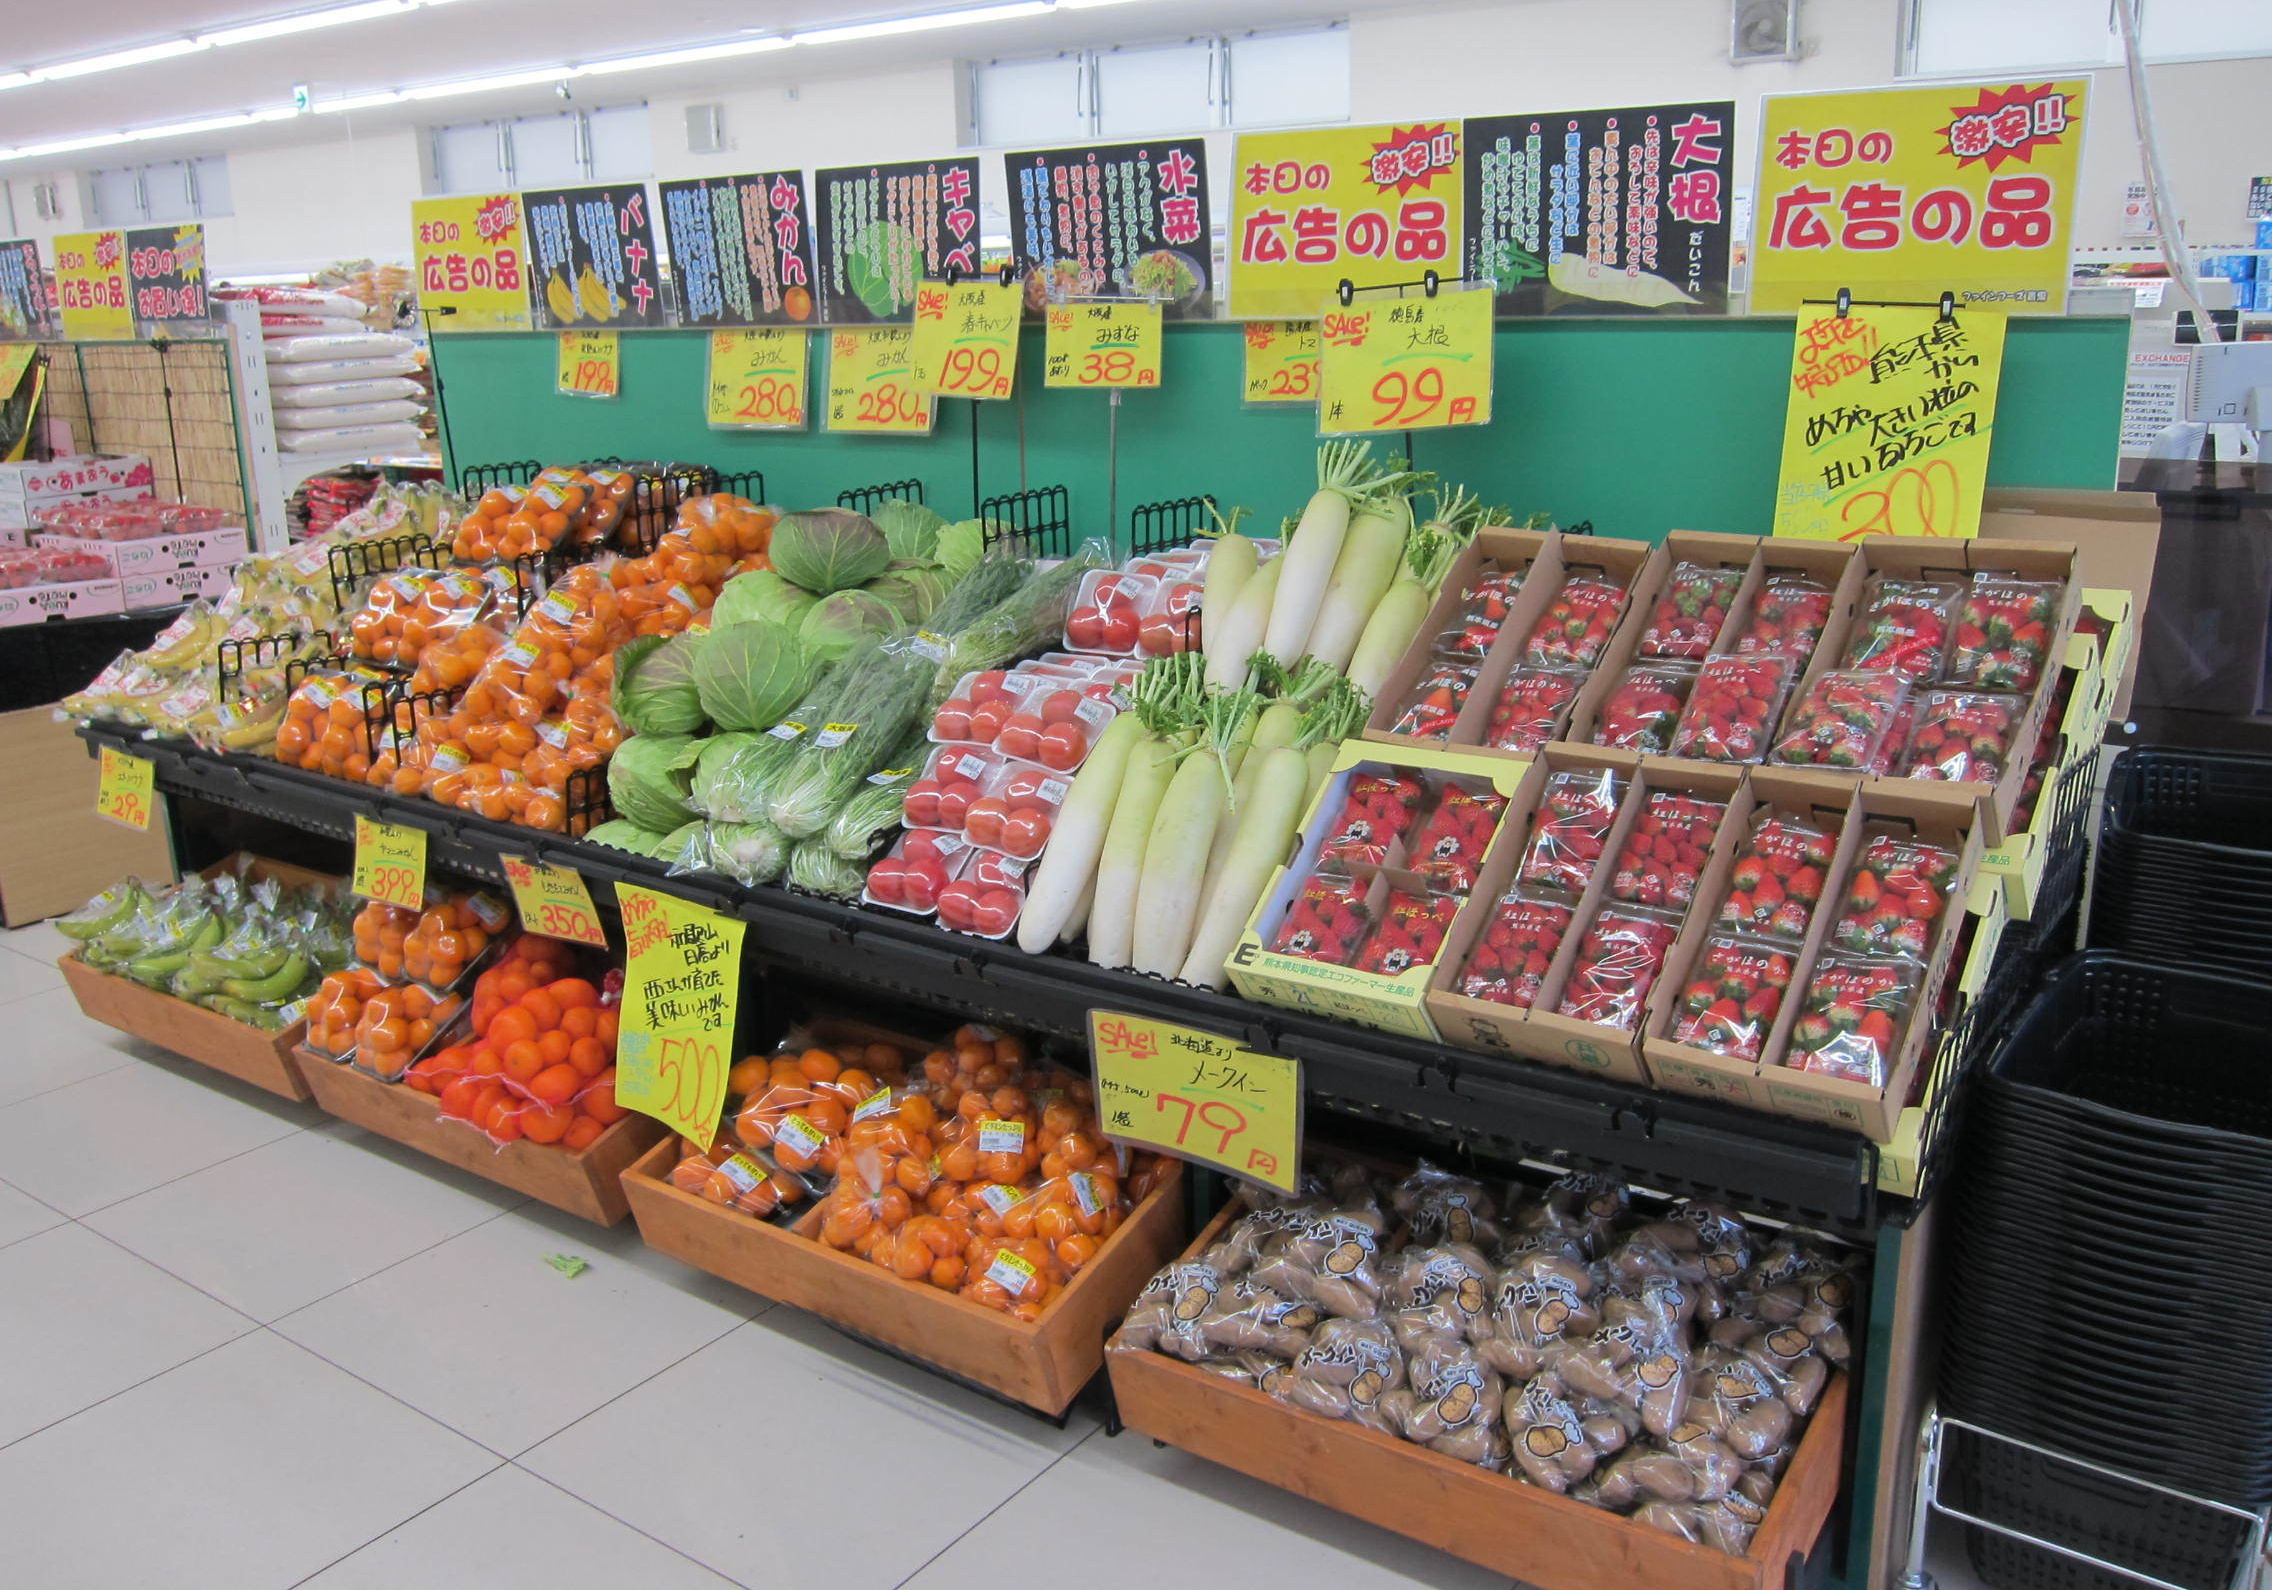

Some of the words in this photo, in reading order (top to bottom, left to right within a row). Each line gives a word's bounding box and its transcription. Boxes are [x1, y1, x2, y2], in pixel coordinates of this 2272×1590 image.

[1951, 94, 2068, 156] 激安!!
[1371, 133, 1455, 184] 激安!!
[1667, 113, 1722, 224] 大根
[1775, 129, 1893, 169] 本日の
[1157, 149, 1201, 244] 水菜
[1243, 161, 1331, 196] 本日の
[1643, 129, 1660, 270] 先は辛味が強いので、
[419, 221, 459, 244] 本日の
[770, 174, 807, 285] みかん
[943, 167, 975, 273] キャベ
[1241, 202, 1448, 264] 広告の品
[1481, 152, 1496, 281] 炒め煮などに使えま
[1626, 145, 1643, 278] おろして薬味などに
[1769, 177, 2052, 249] 広告の品
[422, 249, 520, 293] 広告の品
[621, 194, 653, 316] バナナ
[1688, 231, 1702, 292] だいこん
[62, 275, 126, 309] 広告の品
[751, 349, 787, 367] みかん
[876, 347, 912, 367] みかん
[1096, 326, 1140, 343] みずな
[1300, 338, 1317, 350] トマ
[1407, 325, 1451, 349] 大根
[2134, 354, 2191, 363] EXCHANGE
[1233, 943, 1258, 965] E
[1263, 957, 1416, 998] 熊本県知事認定エコファーマー生産品
